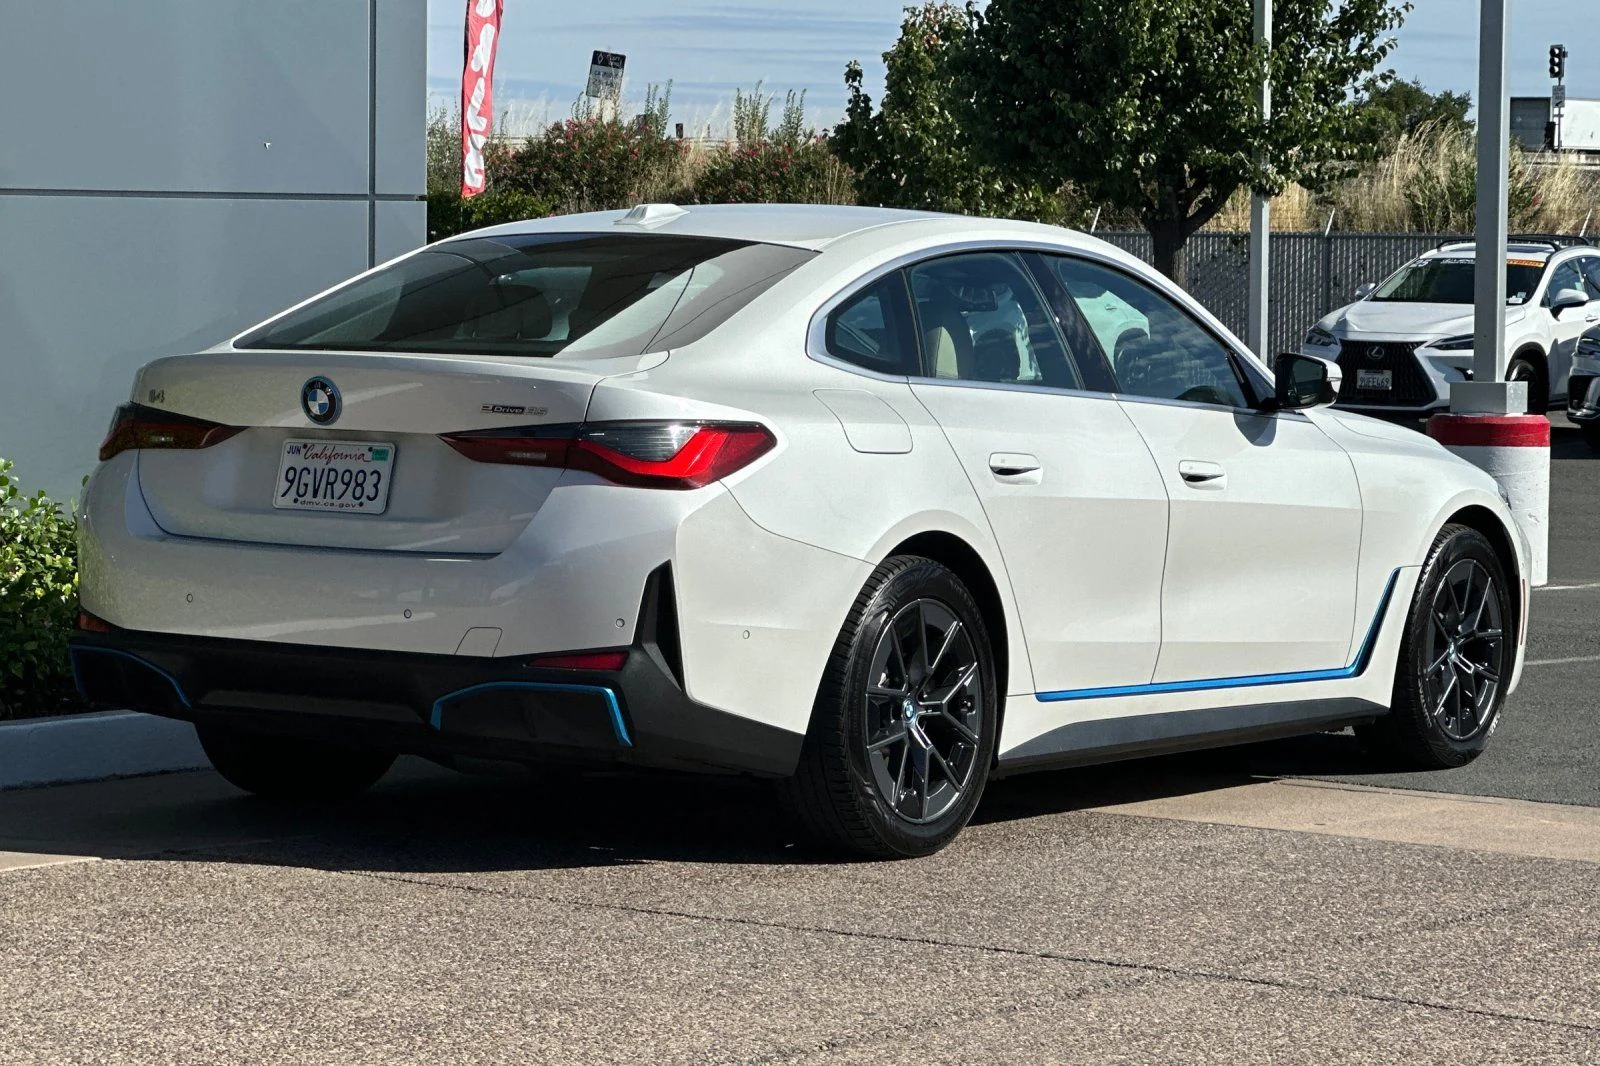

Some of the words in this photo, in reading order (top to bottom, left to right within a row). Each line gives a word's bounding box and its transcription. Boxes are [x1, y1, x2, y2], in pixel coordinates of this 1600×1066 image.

[287, 445, 302, 455] JUN
[303, 444, 371, 465] California
[281, 466, 382, 502] 9GVR983
[300, 500, 357, 508] dmv.ca.gov
